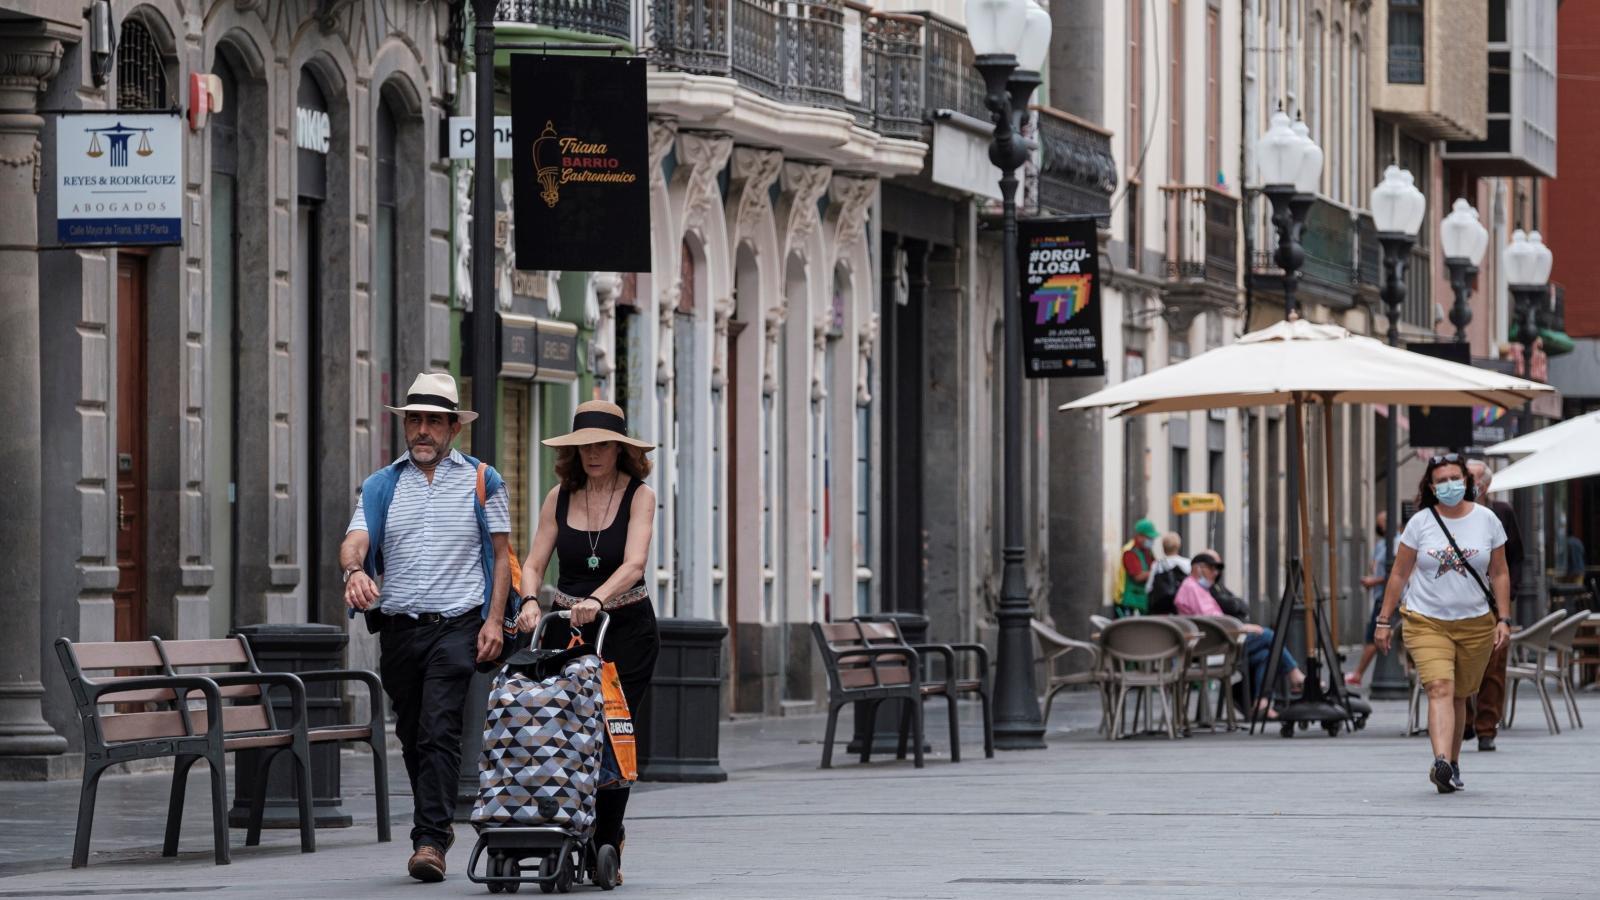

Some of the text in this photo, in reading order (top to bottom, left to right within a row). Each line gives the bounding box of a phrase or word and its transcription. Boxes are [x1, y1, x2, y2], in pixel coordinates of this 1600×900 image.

[460, 128, 513, 148] pnk
[559, 137, 608, 154] Triana
[562, 157, 619, 168] BARRIO
[63, 174, 176, 186] REYES & RODRÍGUEZ
[560, 167, 637, 184] Gastronómico
[72, 202, 167, 213] ABOGADOS
[1029, 248, 1092, 262] #ORGU-
[1028, 261, 1080, 275] LLOSA
[1028, 275, 1043, 284] de
